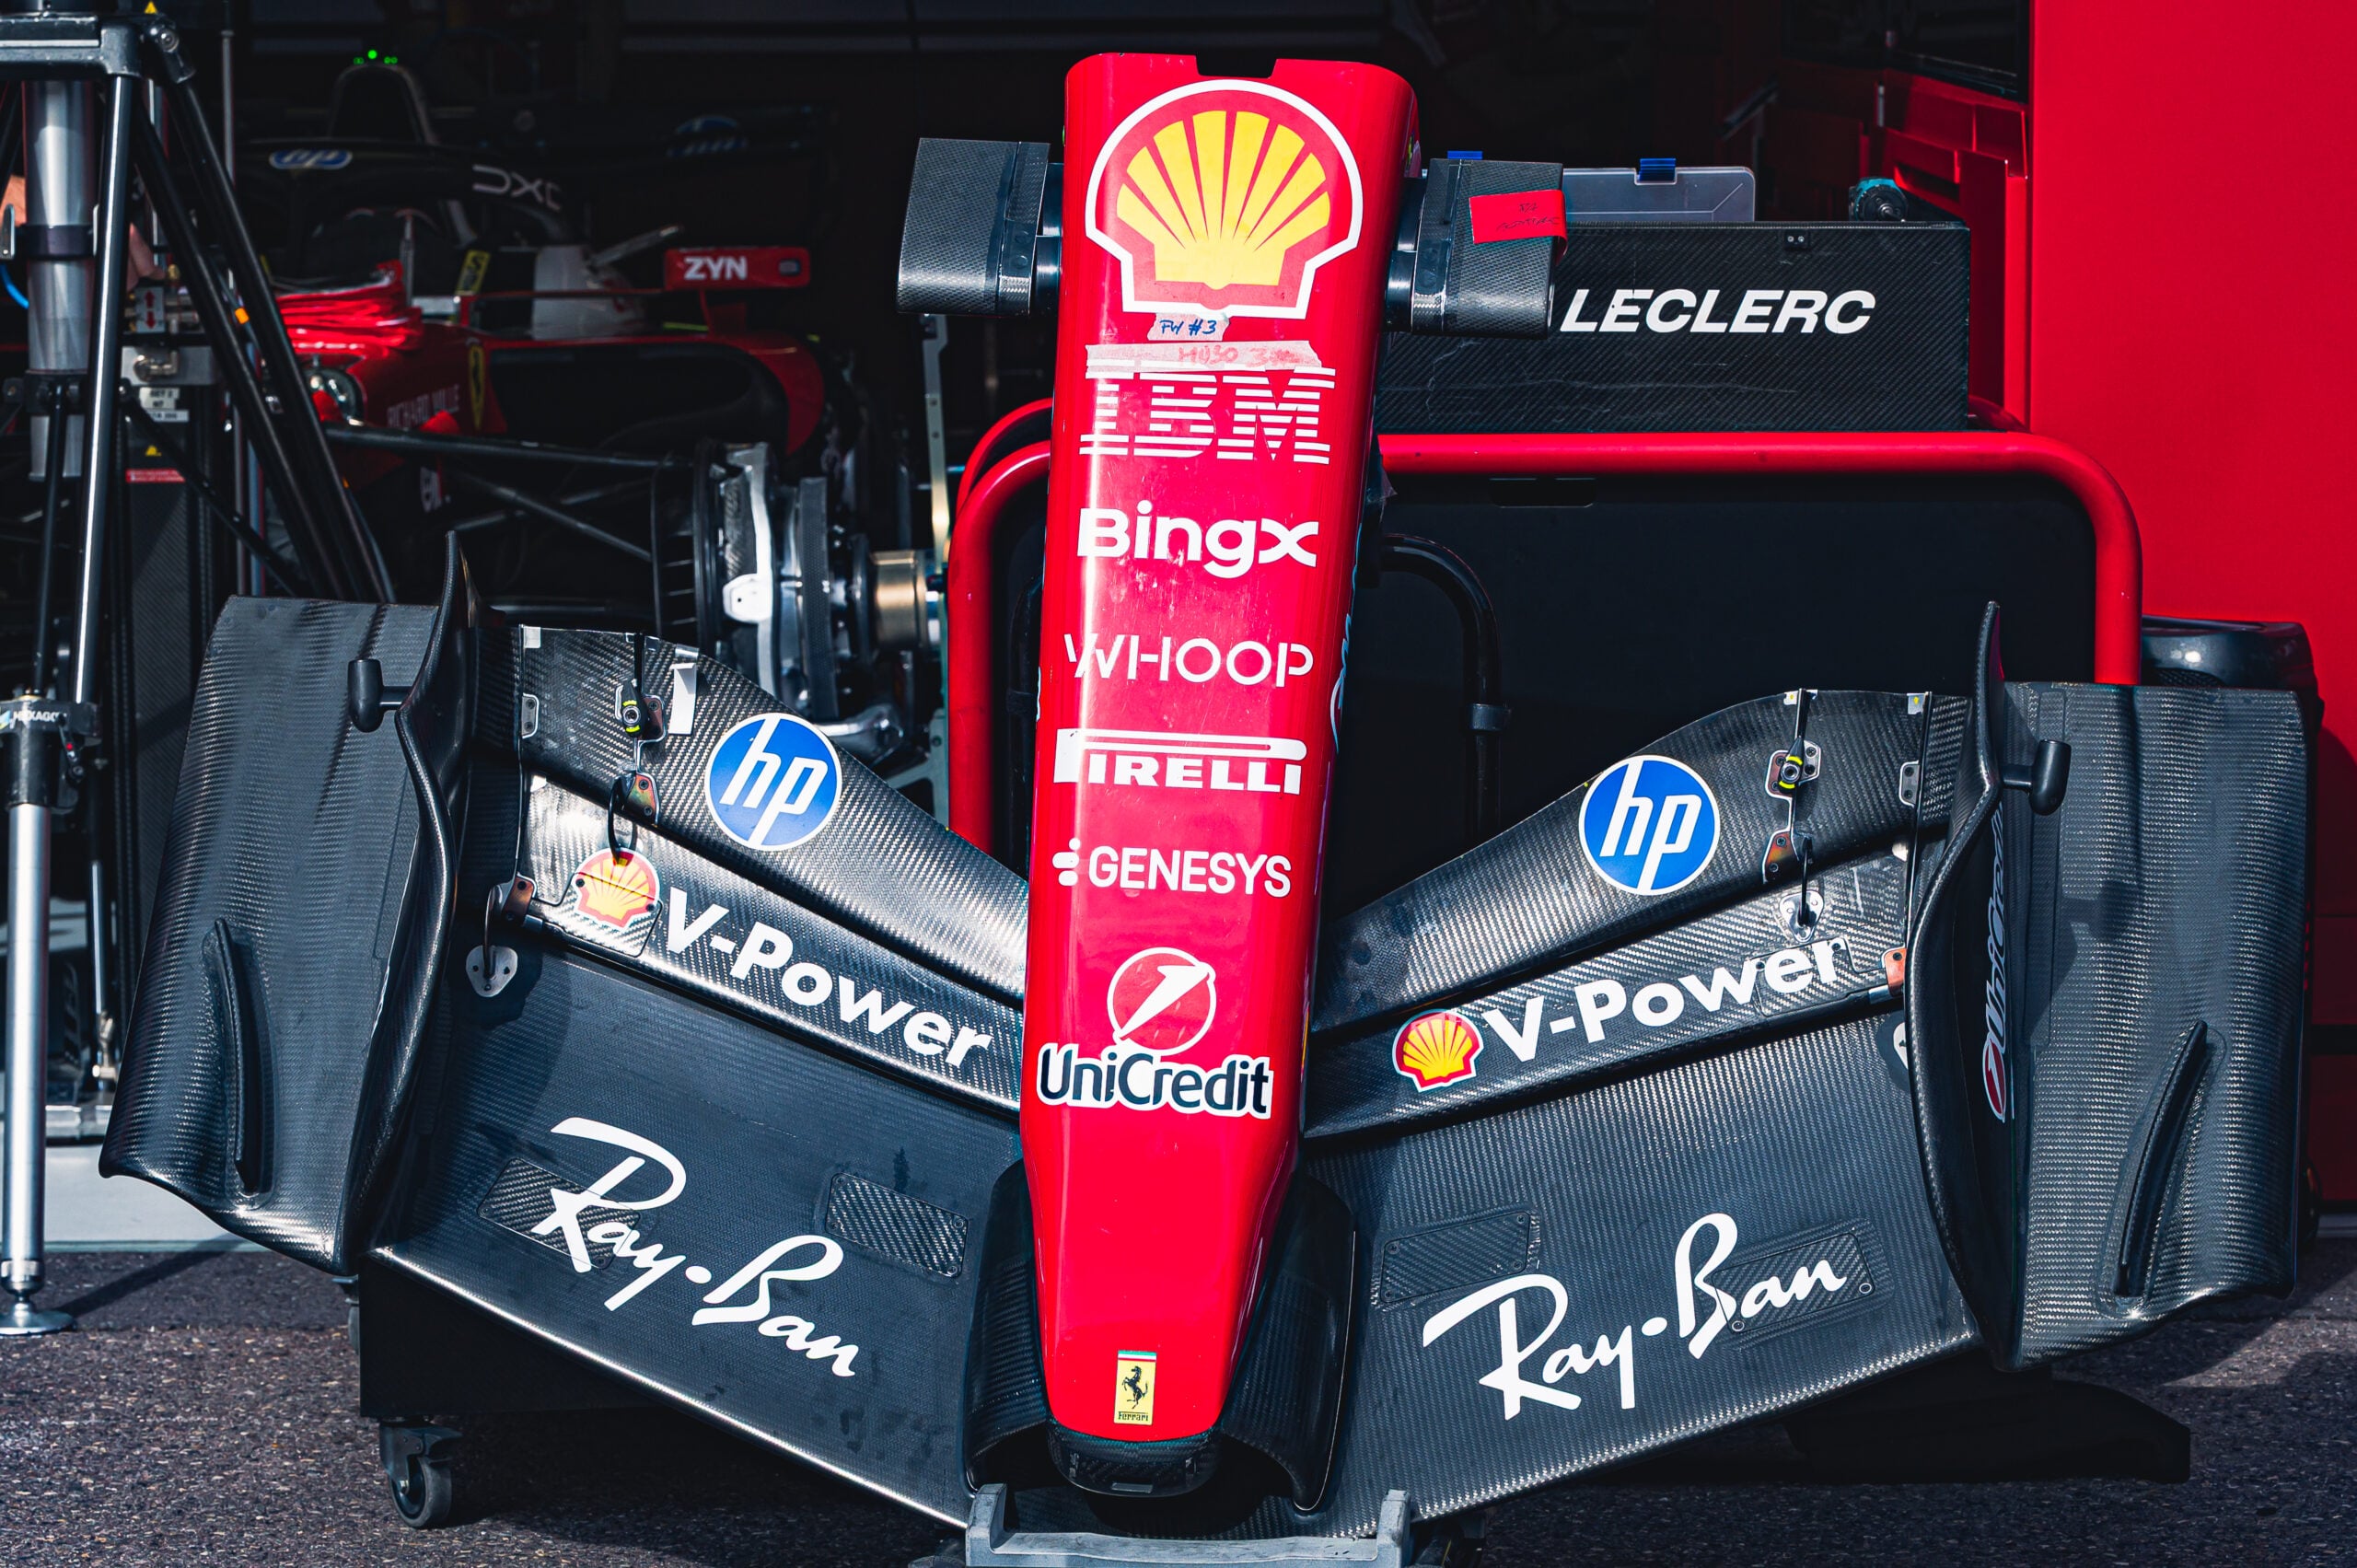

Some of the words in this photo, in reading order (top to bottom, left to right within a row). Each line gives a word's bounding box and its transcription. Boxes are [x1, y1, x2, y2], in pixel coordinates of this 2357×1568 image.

[684, 256, 748, 281] ZYN
[1561, 288, 1876, 334] LECLERC
[1079, 359, 1336, 465] IBM
[1063, 633, 1314, 688] WHOOP
[714, 714, 834, 849] hp
[1053, 728, 1307, 795] PIRELLI
[1594, 756, 1708, 894] hp
[1087, 844, 1292, 898] GENESYS
[666, 887, 993, 1068] V-Power
[1480, 937, 1847, 1063] V-Power
[1039, 1047, 1271, 1116] UniCredit
[1118, 1411, 1149, 1422] Ferrari
